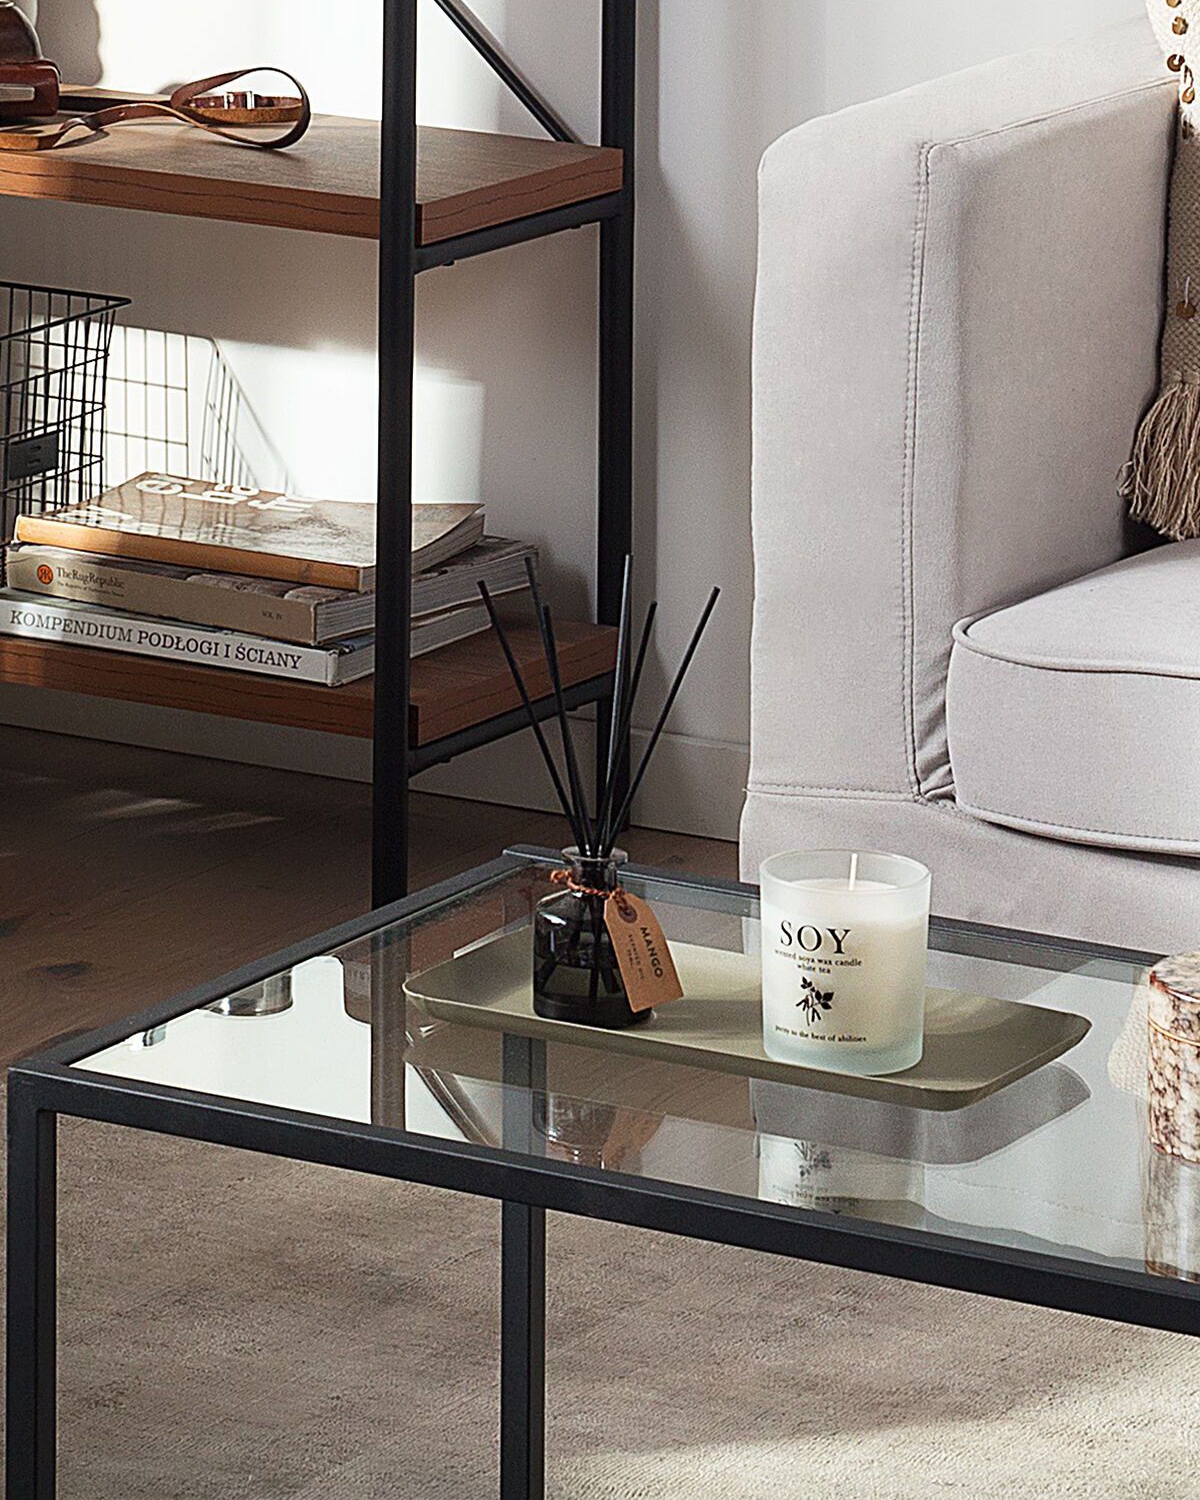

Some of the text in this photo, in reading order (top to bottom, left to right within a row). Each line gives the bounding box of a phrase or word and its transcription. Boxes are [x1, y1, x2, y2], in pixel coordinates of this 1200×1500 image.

[9, 609, 303, 671] KOMPENDIUM PODŁOGI I ŚCIANY
[640, 926, 663, 978] MANGO
[780, 920, 852, 955] SOY
[835, 958, 863, 967] candle
